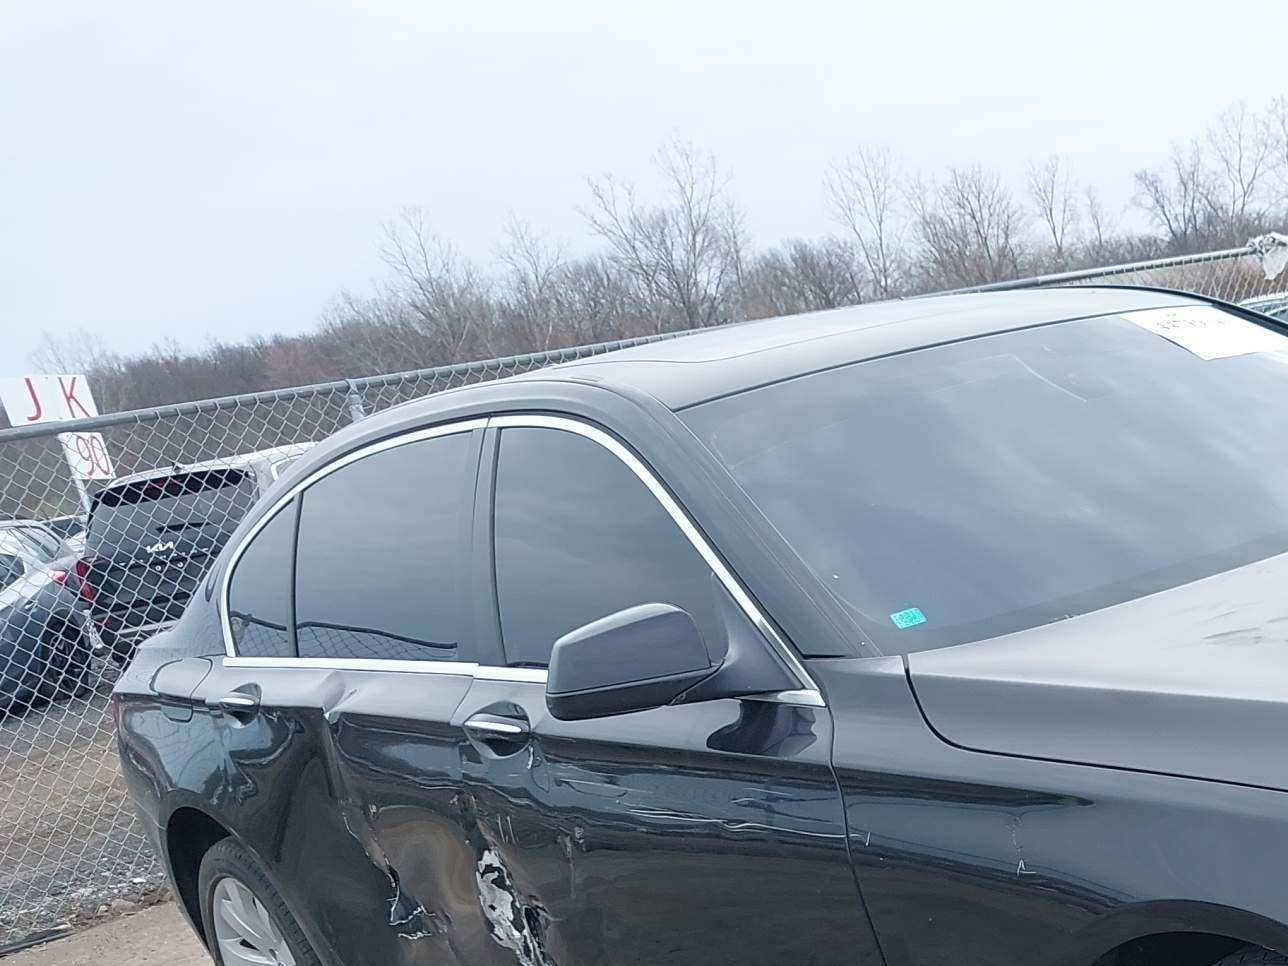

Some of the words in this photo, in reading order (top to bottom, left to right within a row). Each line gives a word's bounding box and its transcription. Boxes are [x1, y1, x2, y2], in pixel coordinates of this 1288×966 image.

[25, 378, 41, 420] J
[59, 377, 90, 417] K
[76, 435, 110, 477] 90
